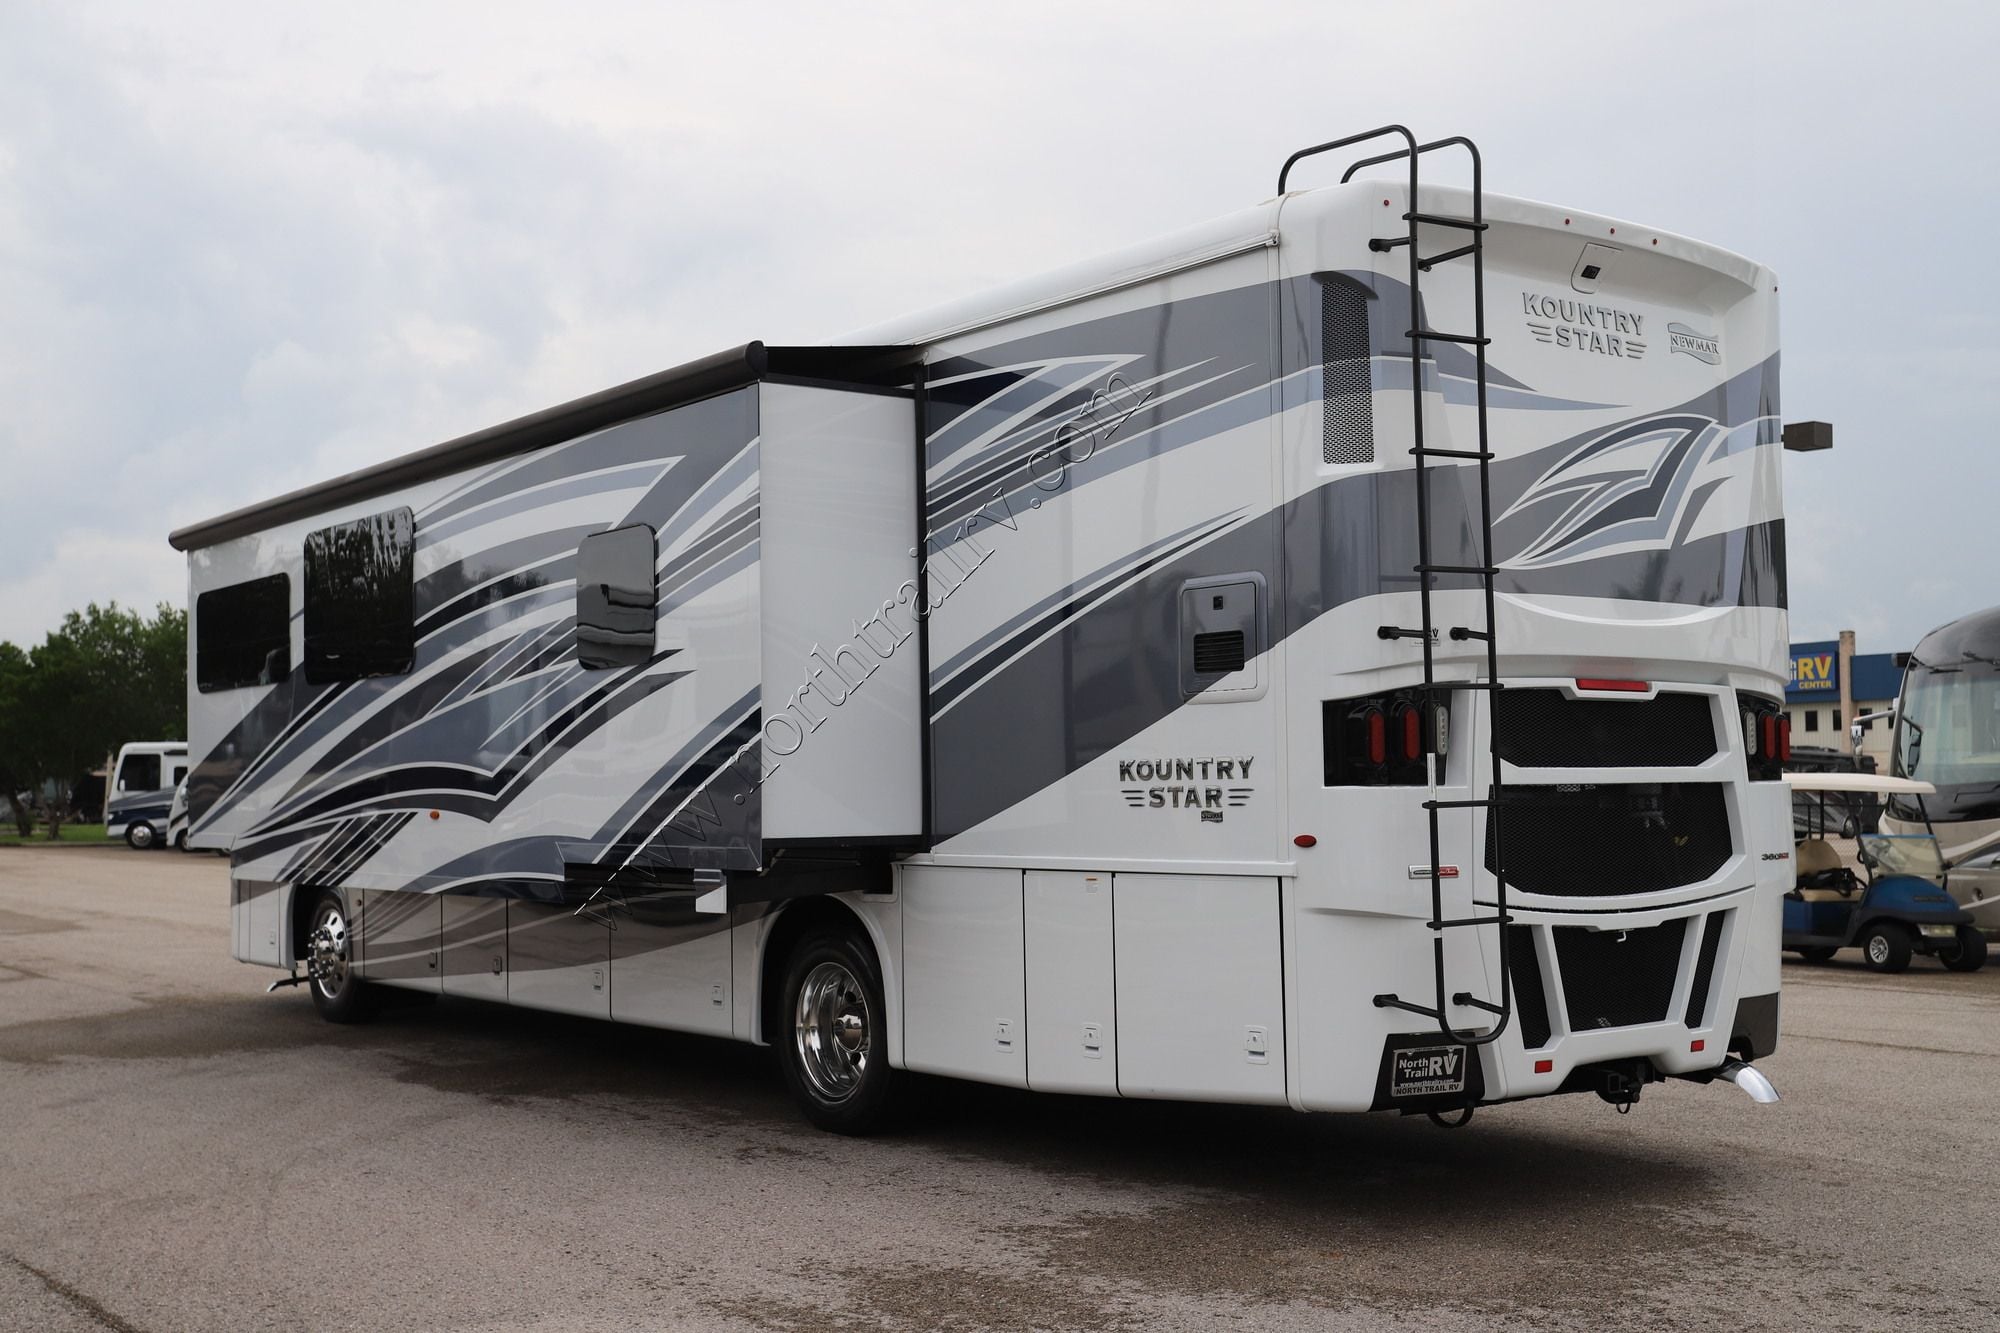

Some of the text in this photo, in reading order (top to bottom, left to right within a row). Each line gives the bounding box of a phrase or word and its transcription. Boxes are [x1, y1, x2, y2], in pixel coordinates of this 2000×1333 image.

[1521, 291, 1644, 336] KOUNTRY
[1555, 325, 1624, 358] STAR
[1670, 334, 1721, 355] NEWMAR
[1798, 657, 1832, 680] RV
[1799, 680, 1832, 689] CENTER
[1118, 755, 1255, 782] KOUNTRY
[1148, 785, 1223, 808] STAR
[1399, 1058, 1428, 1068] North
[1404, 1068, 1428, 1078] Trail
[1429, 1055, 1458, 1076] RV
[1396, 1086, 1422, 1095] NORTH
[1425, 1085, 1447, 1093] TRAIL
